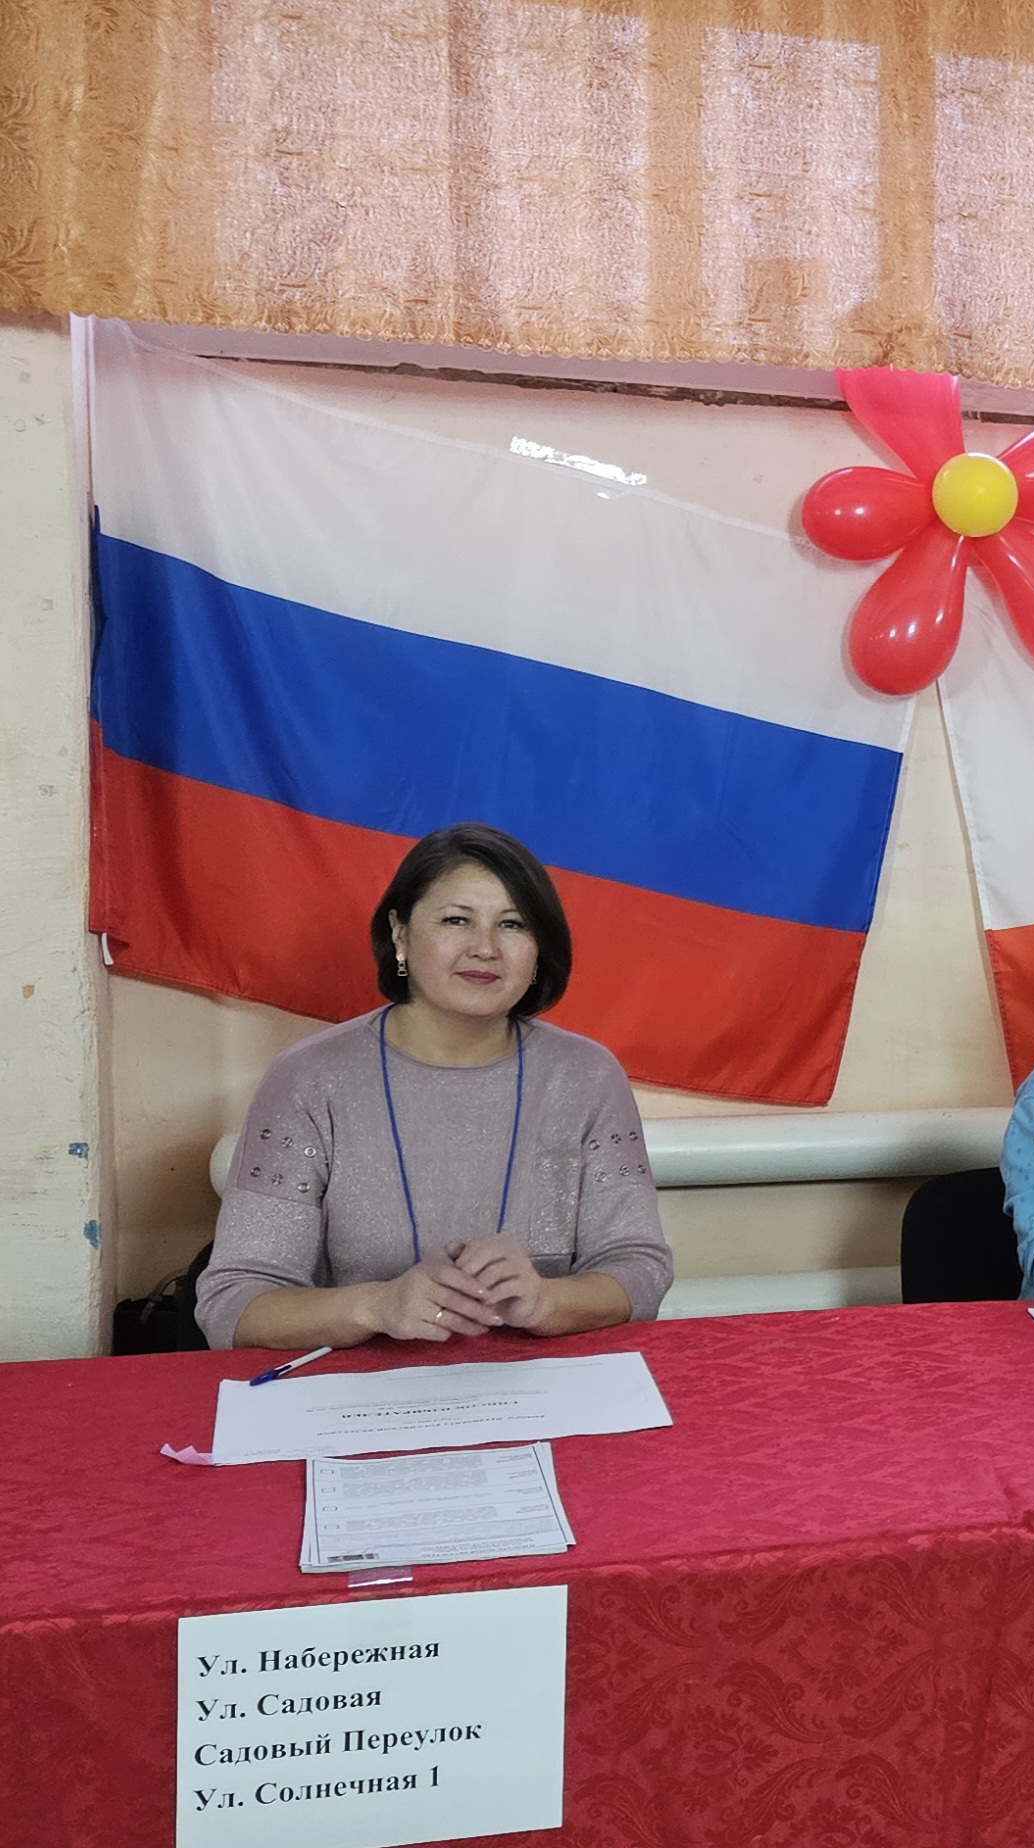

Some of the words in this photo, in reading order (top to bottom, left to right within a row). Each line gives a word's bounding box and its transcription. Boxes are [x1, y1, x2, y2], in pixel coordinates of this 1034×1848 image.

[196, 1654, 248, 1678] Ул.
[258, 1642, 440, 1673] Набережная
[195, 1698, 246, 1722] Ул.
[256, 1690, 382, 1716] Садовая
[194, 1732, 332, 1767] Садовый
[341, 1724, 482, 1755] Переулок
[193, 1788, 244, 1812] Ул.
[254, 1773, 418, 1805] Солнечная
[428, 1765, 440, 1788] 1
